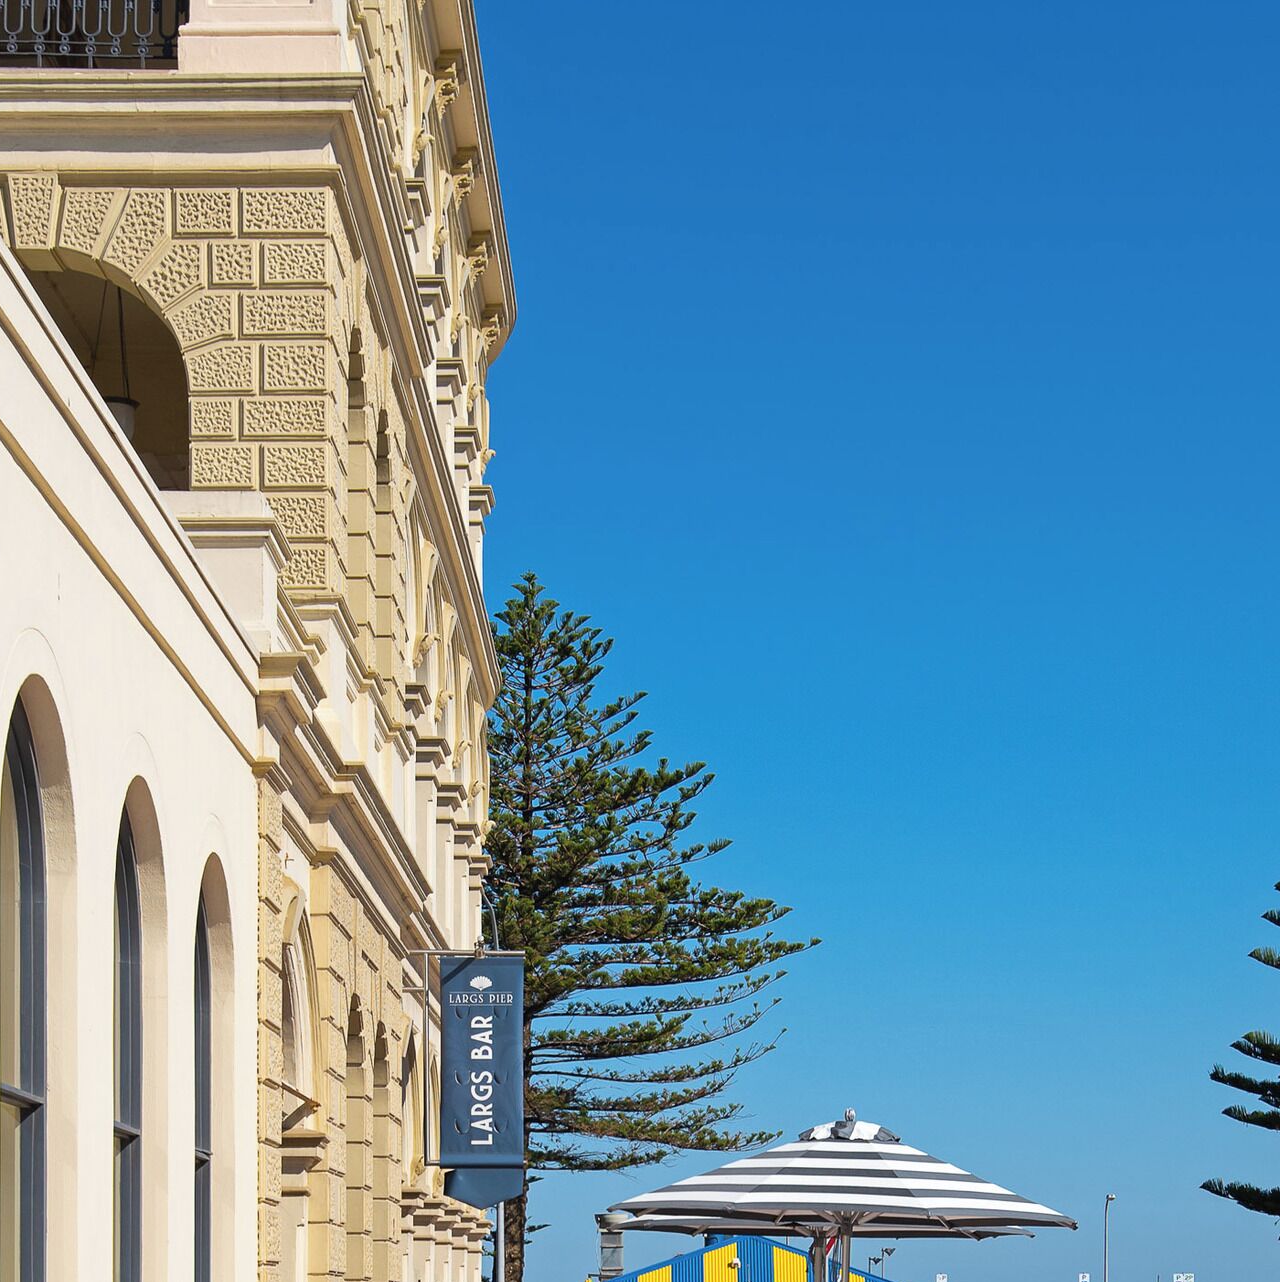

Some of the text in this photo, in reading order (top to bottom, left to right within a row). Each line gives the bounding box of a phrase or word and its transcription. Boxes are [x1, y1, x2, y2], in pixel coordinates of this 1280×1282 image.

[449, 993, 513, 1004] LARGS PIER
[470, 1015, 493, 1145] LARGS BAR
